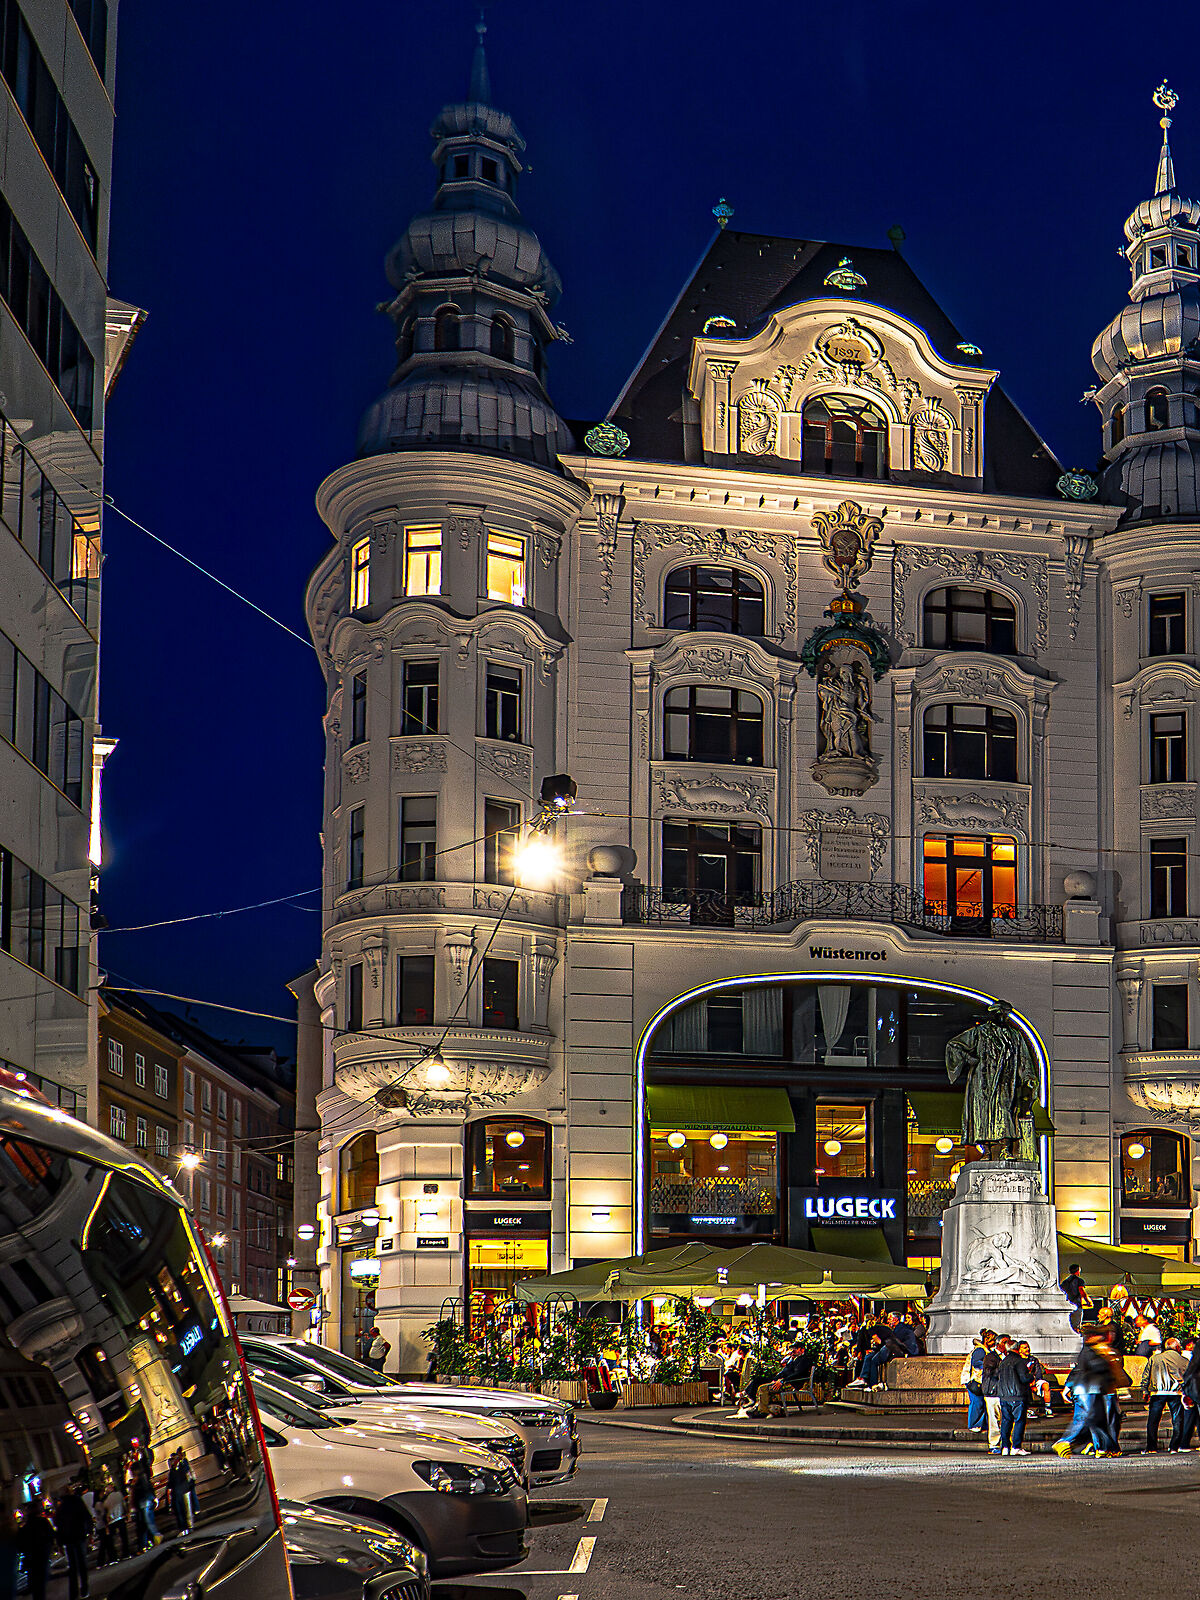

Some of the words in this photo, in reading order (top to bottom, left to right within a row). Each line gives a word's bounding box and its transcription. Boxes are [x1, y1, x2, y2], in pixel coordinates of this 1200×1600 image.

[833, 347, 860, 358] 1897
[809, 946, 887, 961] Wüstenrot
[805, 1197, 896, 1219] LUGECK
[494, 1217, 522, 1225] LUGECK
